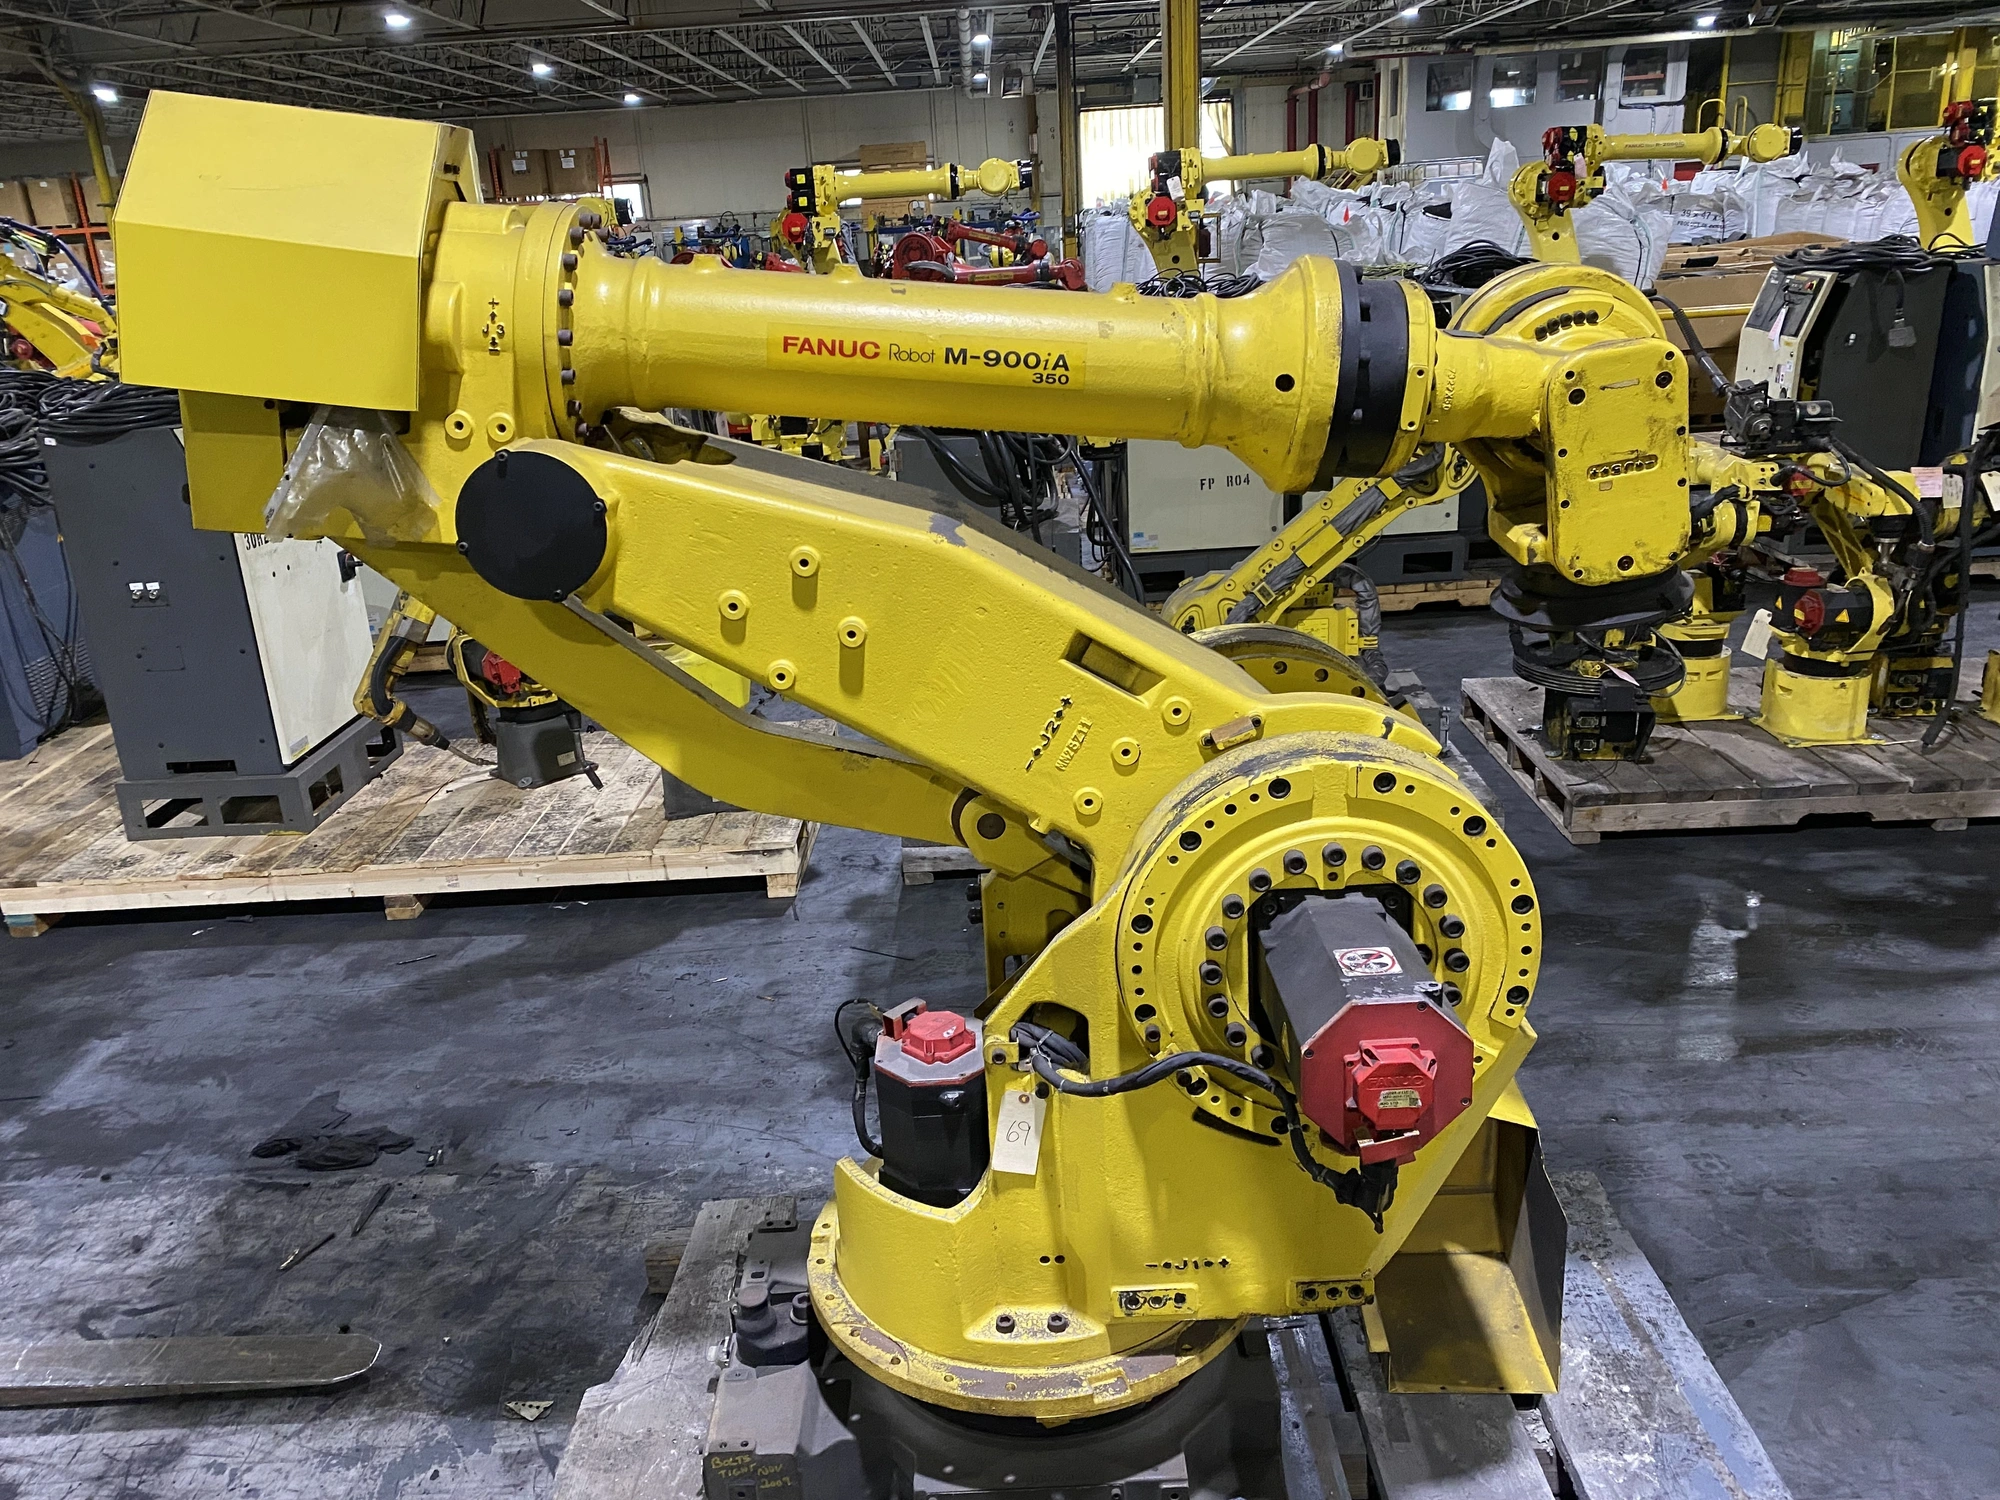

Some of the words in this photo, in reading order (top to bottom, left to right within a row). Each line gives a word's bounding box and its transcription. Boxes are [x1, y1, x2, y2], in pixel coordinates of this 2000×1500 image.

[783, 336, 880, 359] FANUC
[889, 343, 935, 363] Robot
[944, 347, 1070, 371] M-900iA
[1032, 372, 1069, 385] 350
[1200, 478, 1215, 490] FP
[1226, 474, 1250, 487] R04
[1368, 1075, 1424, 1089] FANUC
[1006, 1120, 1031, 1146] 69
[711, 1454, 752, 1469] BOLTS
[718, 1463, 757, 1478] TIGHT
